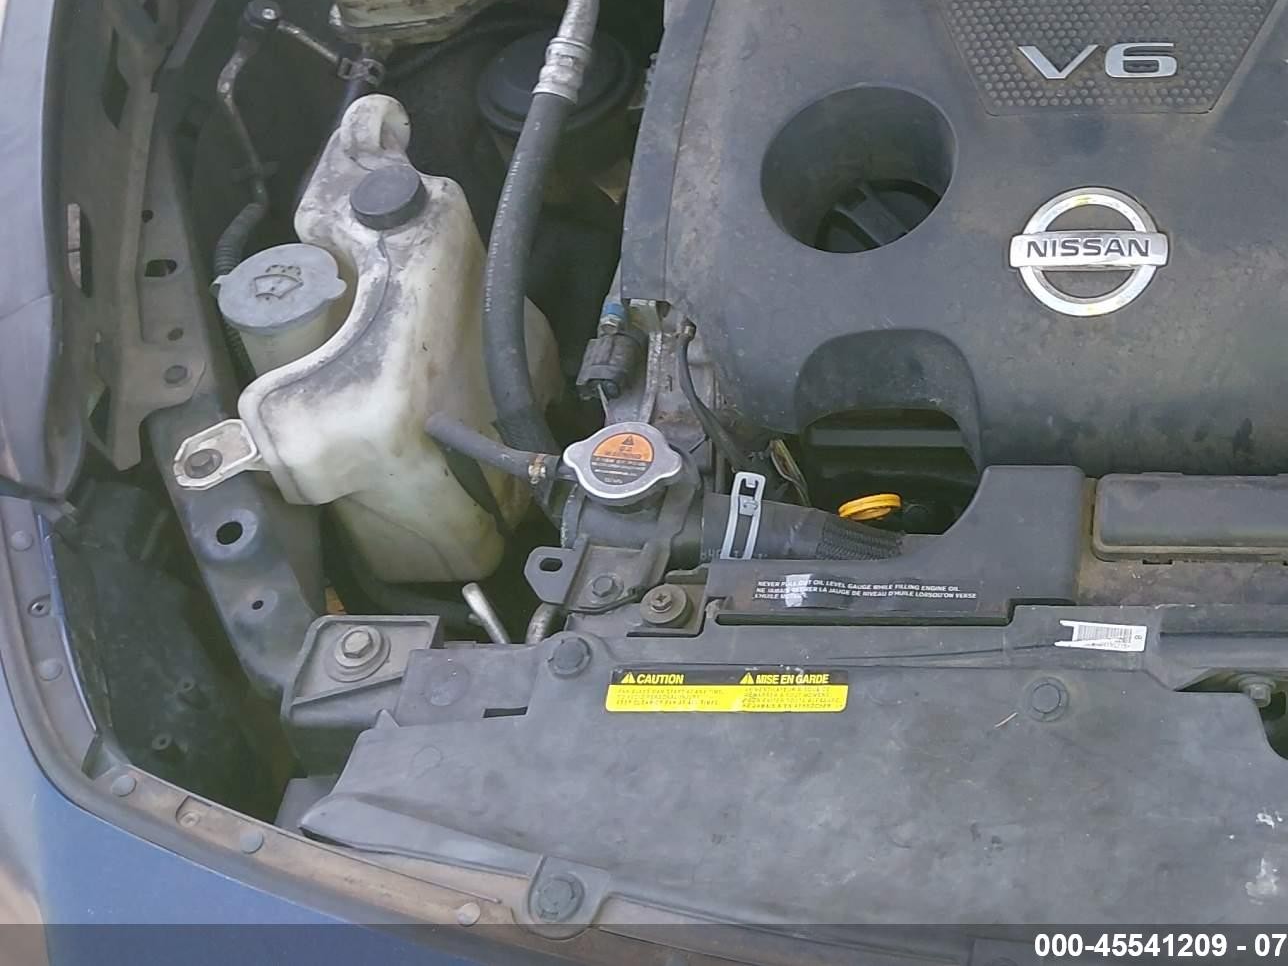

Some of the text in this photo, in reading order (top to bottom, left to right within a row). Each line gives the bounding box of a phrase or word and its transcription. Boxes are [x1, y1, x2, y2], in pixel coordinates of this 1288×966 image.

[1017, 42, 1178, 81] V6
[1026, 237, 1150, 259] NISSAN
[825, 580, 846, 589] LEVEL
[828, 588, 850, 596] JAUGE
[636, 673, 685, 684] CAUTION
[755, 674, 830, 684] MISE EN GARDE
